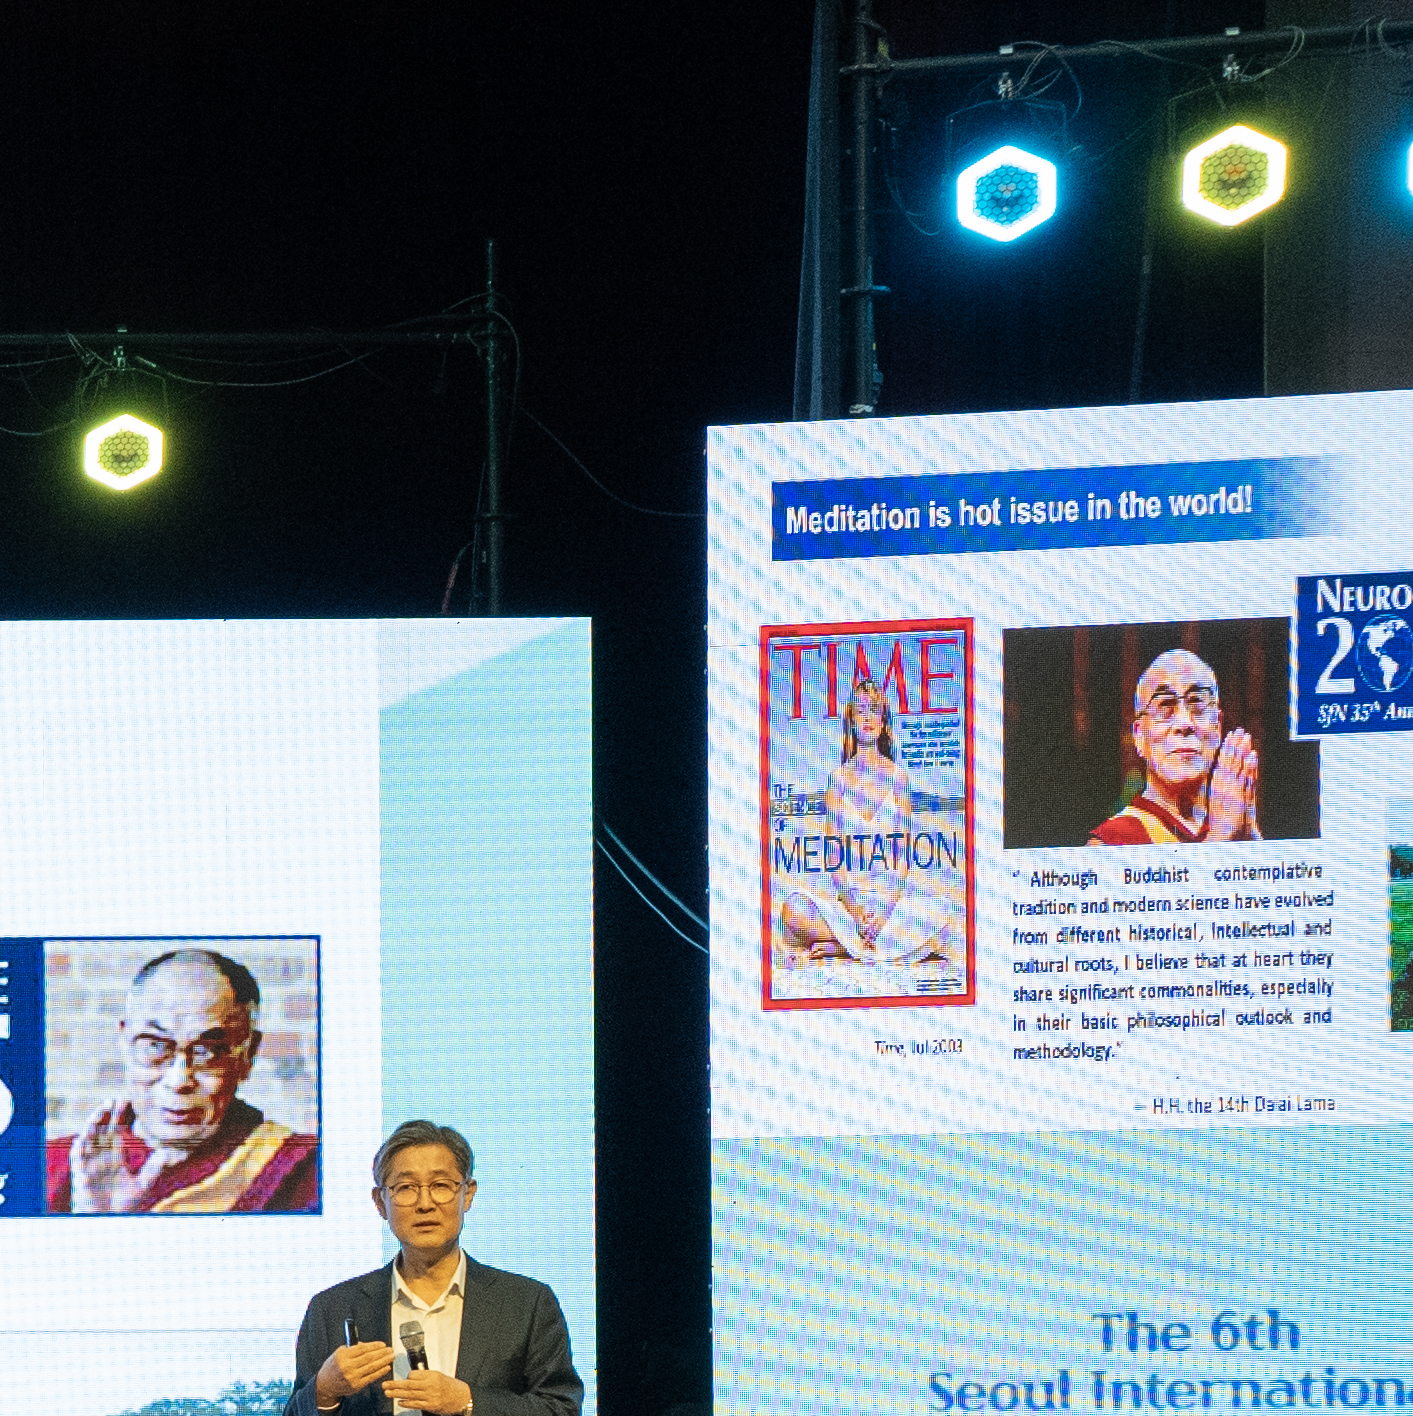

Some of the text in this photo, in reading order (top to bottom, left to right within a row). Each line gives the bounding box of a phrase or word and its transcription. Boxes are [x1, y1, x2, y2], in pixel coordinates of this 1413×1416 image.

[785, 486, 1253, 535] Meditation is hot issue in the world!
[774, 635, 959, 720] TIME
[772, 829, 959, 875] MEDITATION
[1122, 866, 1191, 885] Buddhist
[1213, 860, 1324, 883] contemplative
[1012, 889, 1335, 916] tradition and modern science have evolved
[1012, 927, 1048, 945] from
[1304, 918, 1333, 937] and
[1135, 952, 1189, 971] believe
[1194, 951, 1227, 969] that
[1231, 952, 1248, 968] at
[1253, 950, 1294, 968] heart
[1299, 949, 1335, 970] they
[1012, 984, 1054, 1002] share
[1058, 983, 1135, 1005] significant
[1260, 977, 1335, 999] especially
[1012, 1013, 1027, 1033] in
[1035, 1012, 1071, 1031] their
[1081, 1011, 1118, 1031] basic
[1303, 1007, 1333, 1025] and
[1092, 1308, 1303, 1352] The 6th
[927, 1370, 1071, 1413] Seoul
